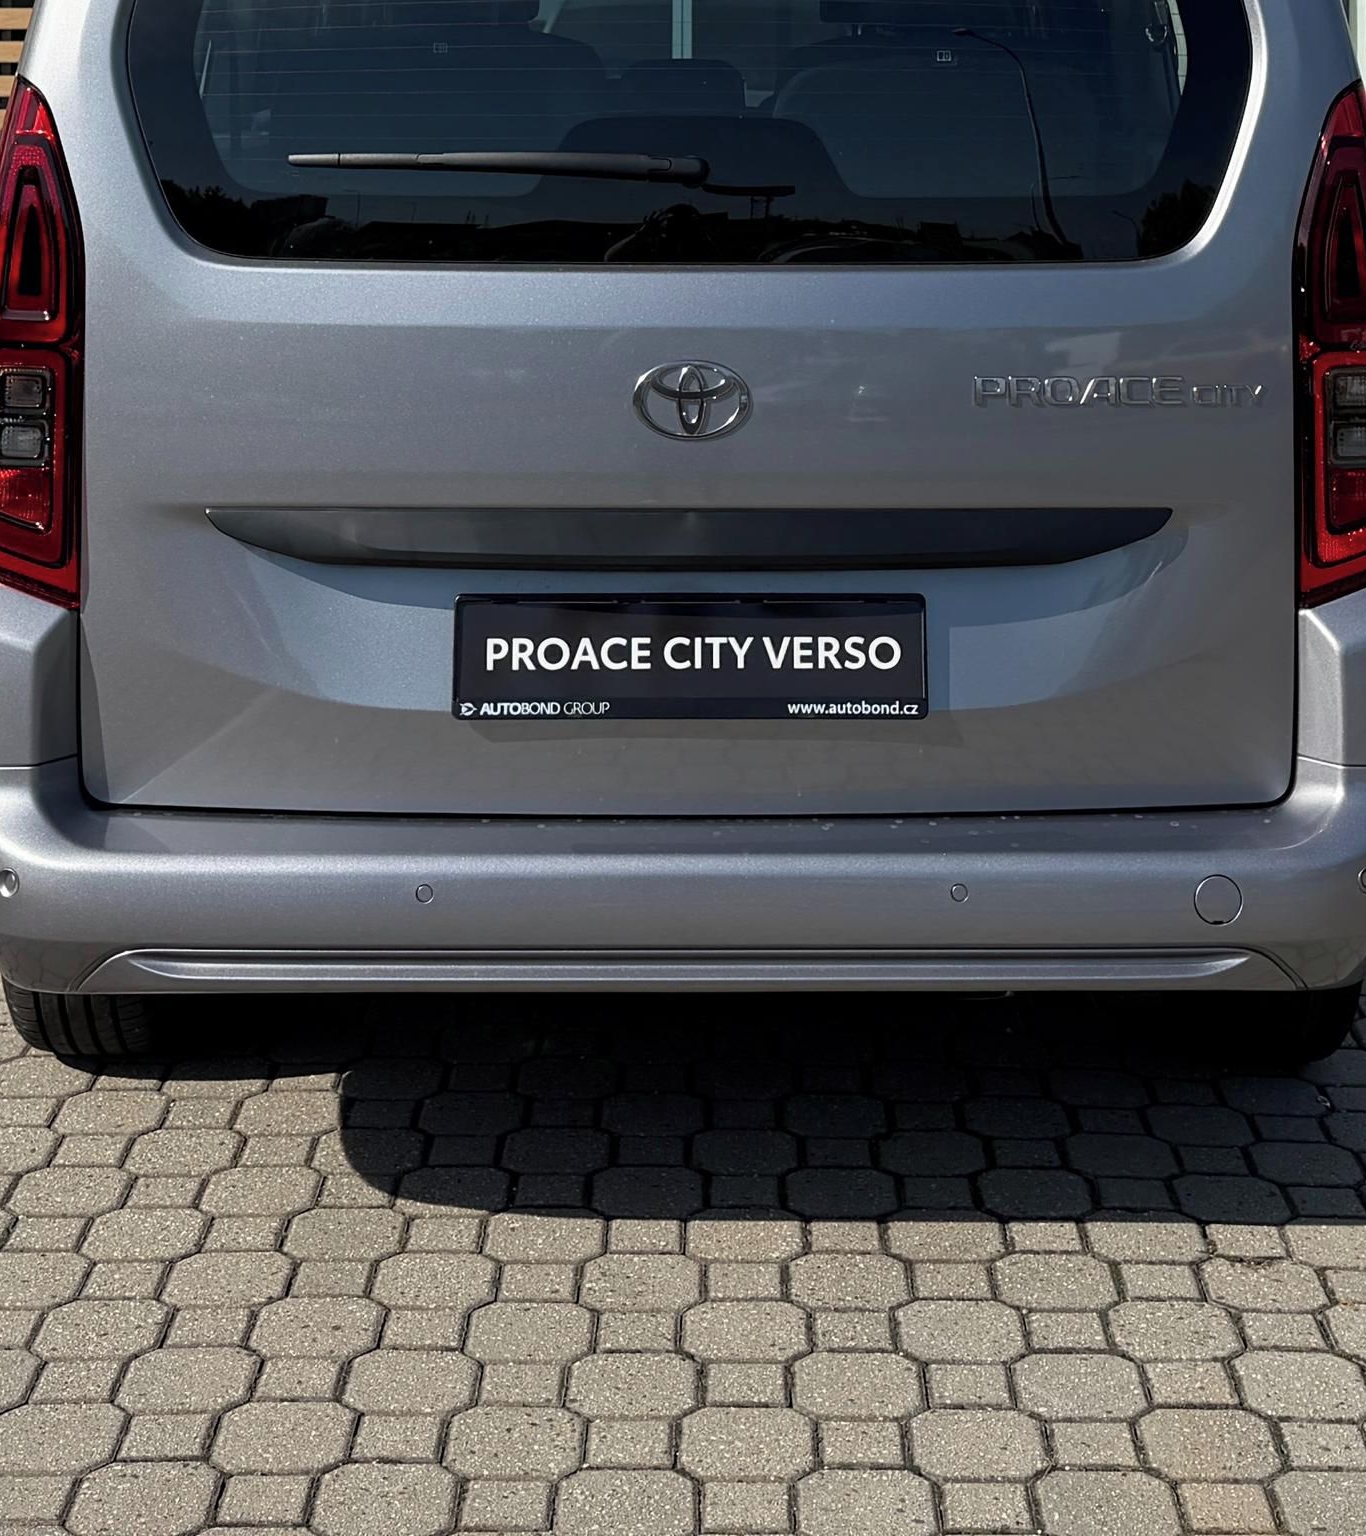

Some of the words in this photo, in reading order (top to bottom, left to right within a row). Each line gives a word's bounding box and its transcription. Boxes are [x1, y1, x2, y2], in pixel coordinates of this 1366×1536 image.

[973, 375, 1184, 407] PROACE
[485, 637, 651, 671] PROACE
[663, 637, 753, 670] CITY
[762, 636, 902, 669] VERSO
[480, 702, 561, 716] AUTOBOND
[563, 702, 610, 715] GROUP
[787, 700, 919, 716] www.autobond.cz
